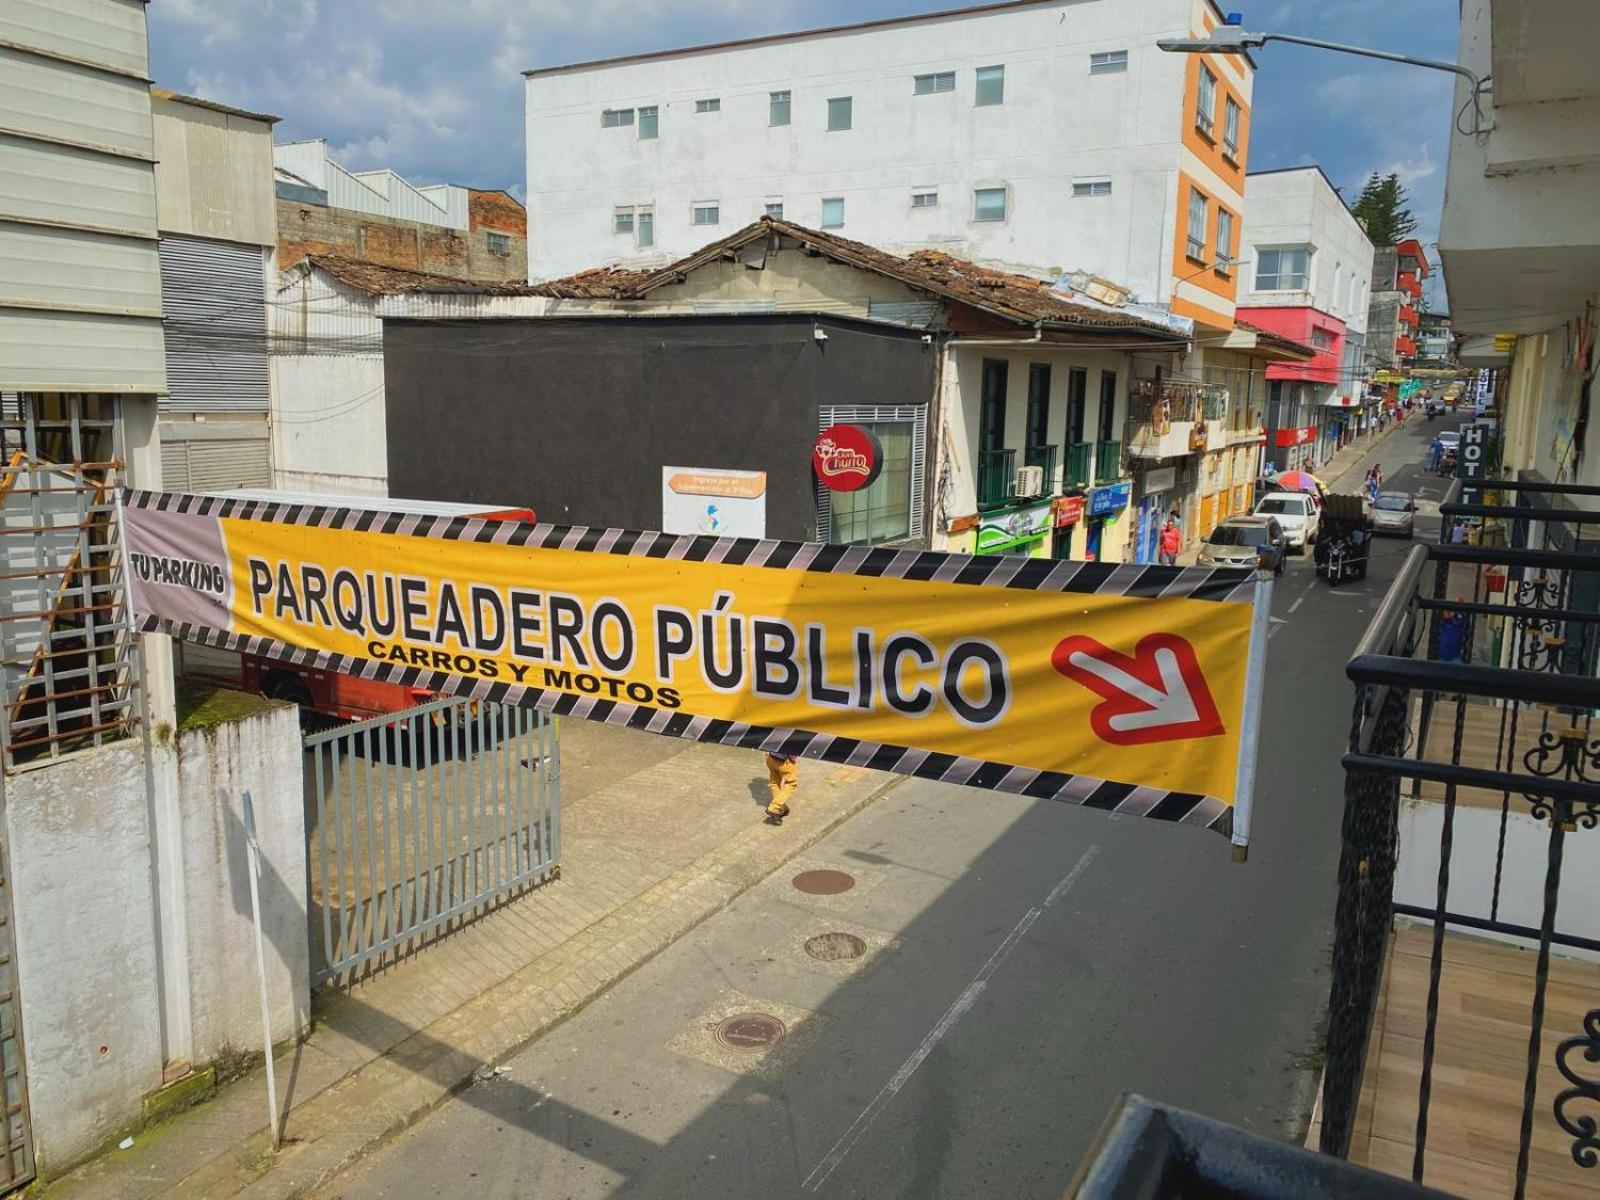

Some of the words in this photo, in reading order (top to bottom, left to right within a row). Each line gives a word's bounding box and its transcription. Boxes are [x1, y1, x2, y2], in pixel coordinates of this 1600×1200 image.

[1463, 429, 1482, 504] HOT
[130, 553, 150, 581] TU
[150, 556, 225, 594] PARKING
[248, 558, 634, 673] PARQUEADERO
[655, 594, 1007, 724] PÚBLICO
[367, 640, 499, 678] CARROS
[508, 662, 531, 683] Y
[544, 667, 681, 708] MOTOS
